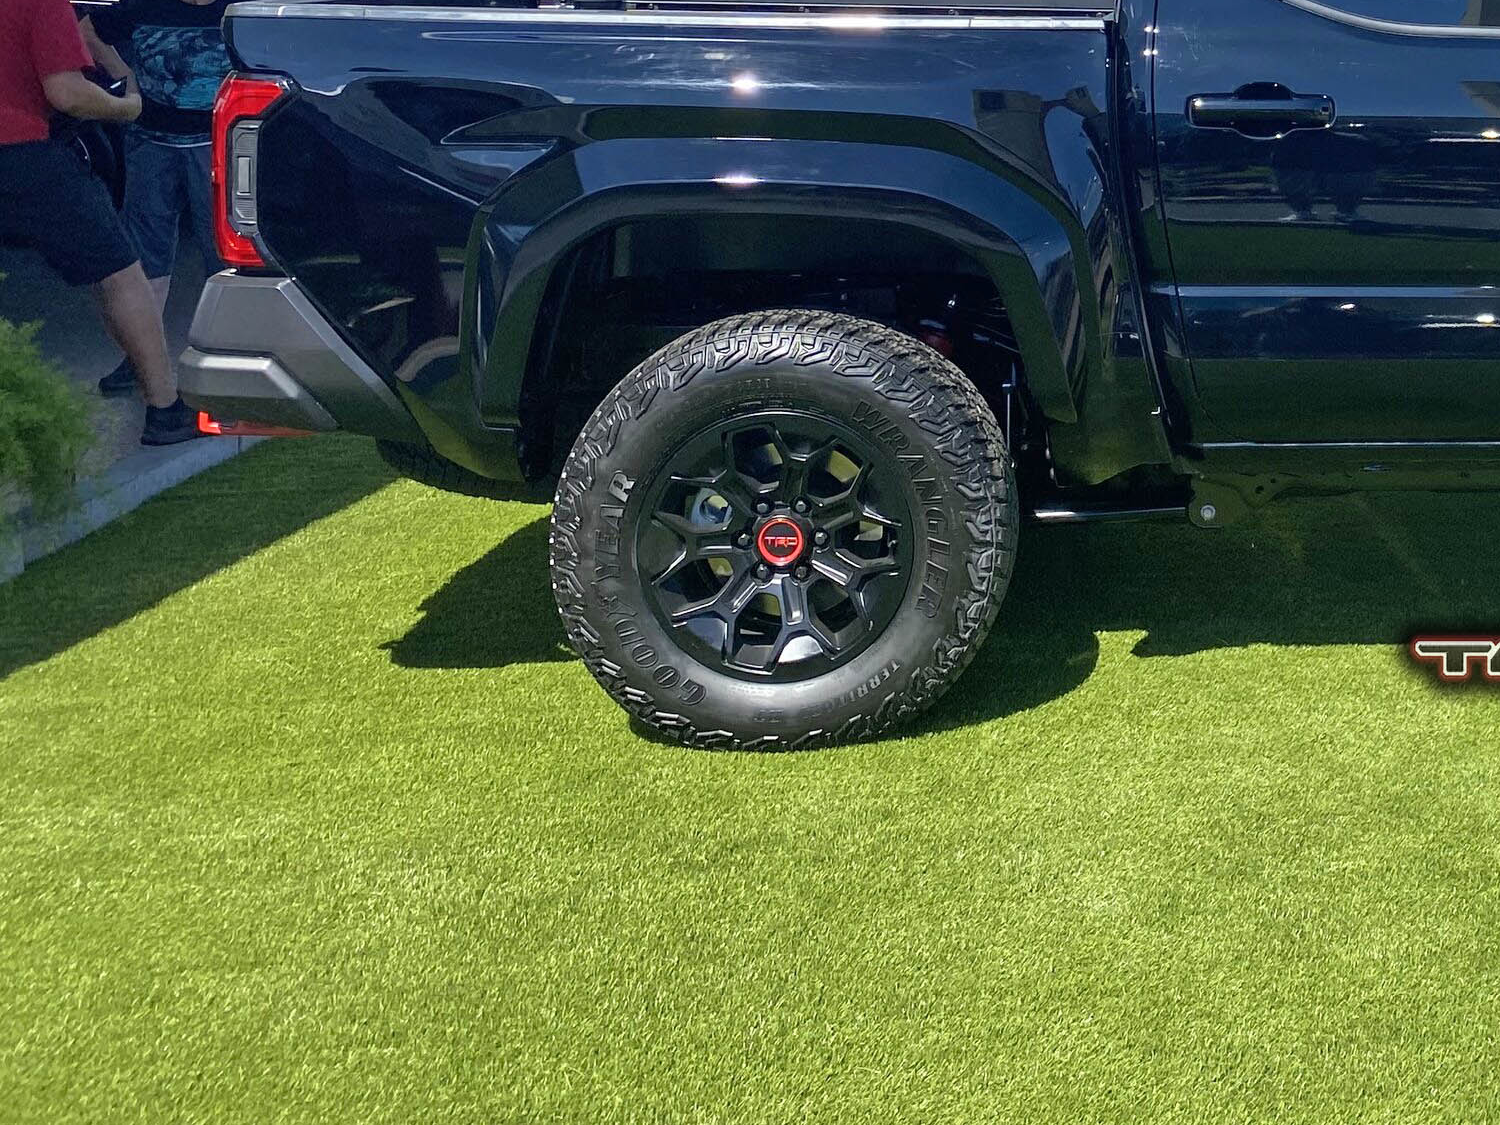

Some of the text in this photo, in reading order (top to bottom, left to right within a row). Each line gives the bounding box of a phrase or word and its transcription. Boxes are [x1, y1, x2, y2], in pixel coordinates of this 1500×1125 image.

[590, 469, 707, 706] GOODYEAR
[764, 536, 798, 548] TRD
[852, 399, 952, 619] WRANGLER
